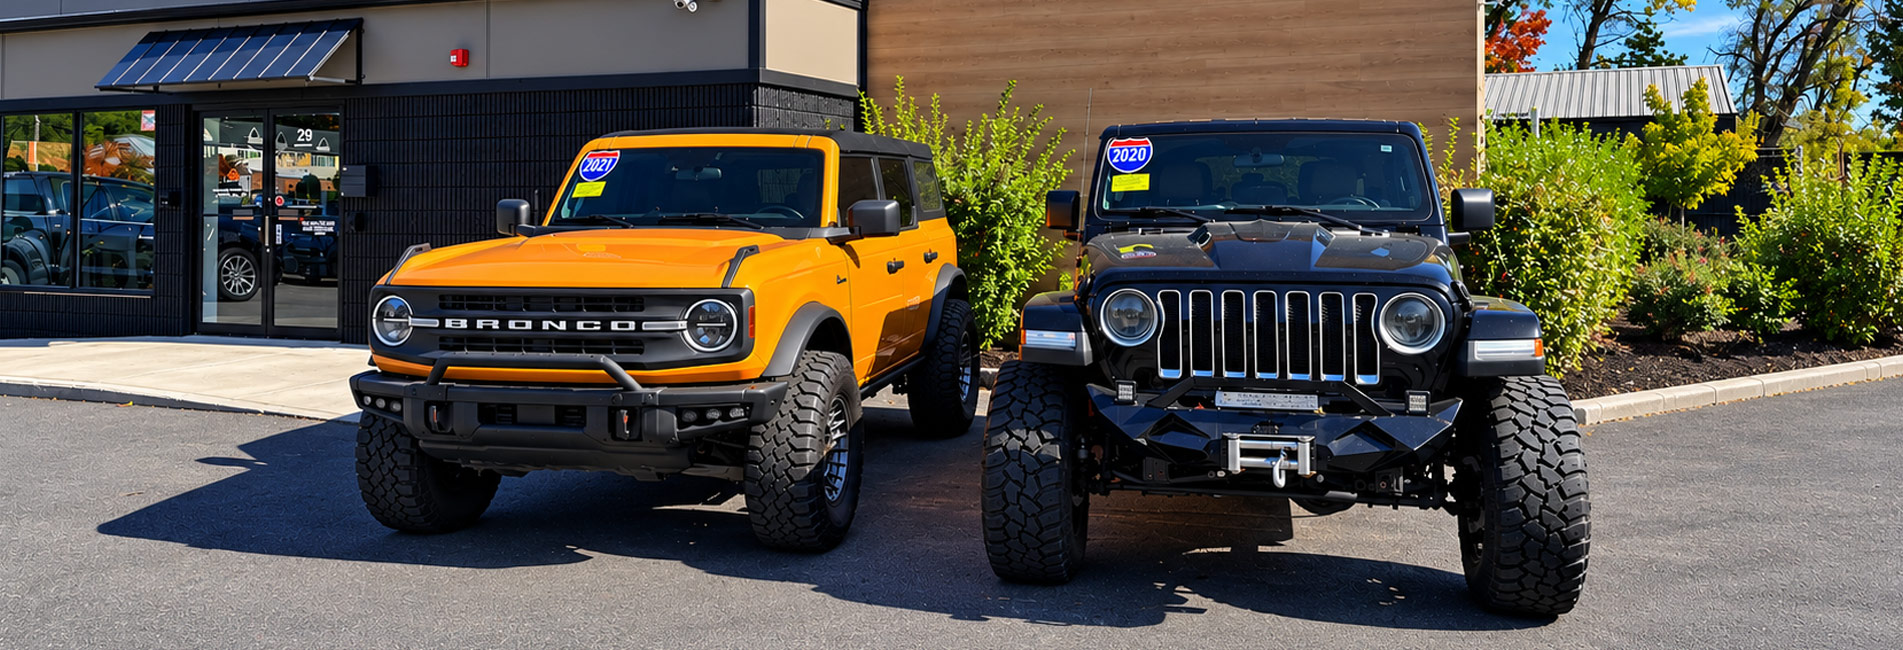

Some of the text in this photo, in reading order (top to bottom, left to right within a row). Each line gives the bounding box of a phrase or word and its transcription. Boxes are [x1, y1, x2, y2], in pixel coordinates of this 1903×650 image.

[297, 128, 313, 142] 29
[1112, 147, 1147, 163] 2020
[582, 158, 613, 172] 2021
[445, 318, 636, 331] BRONCO
